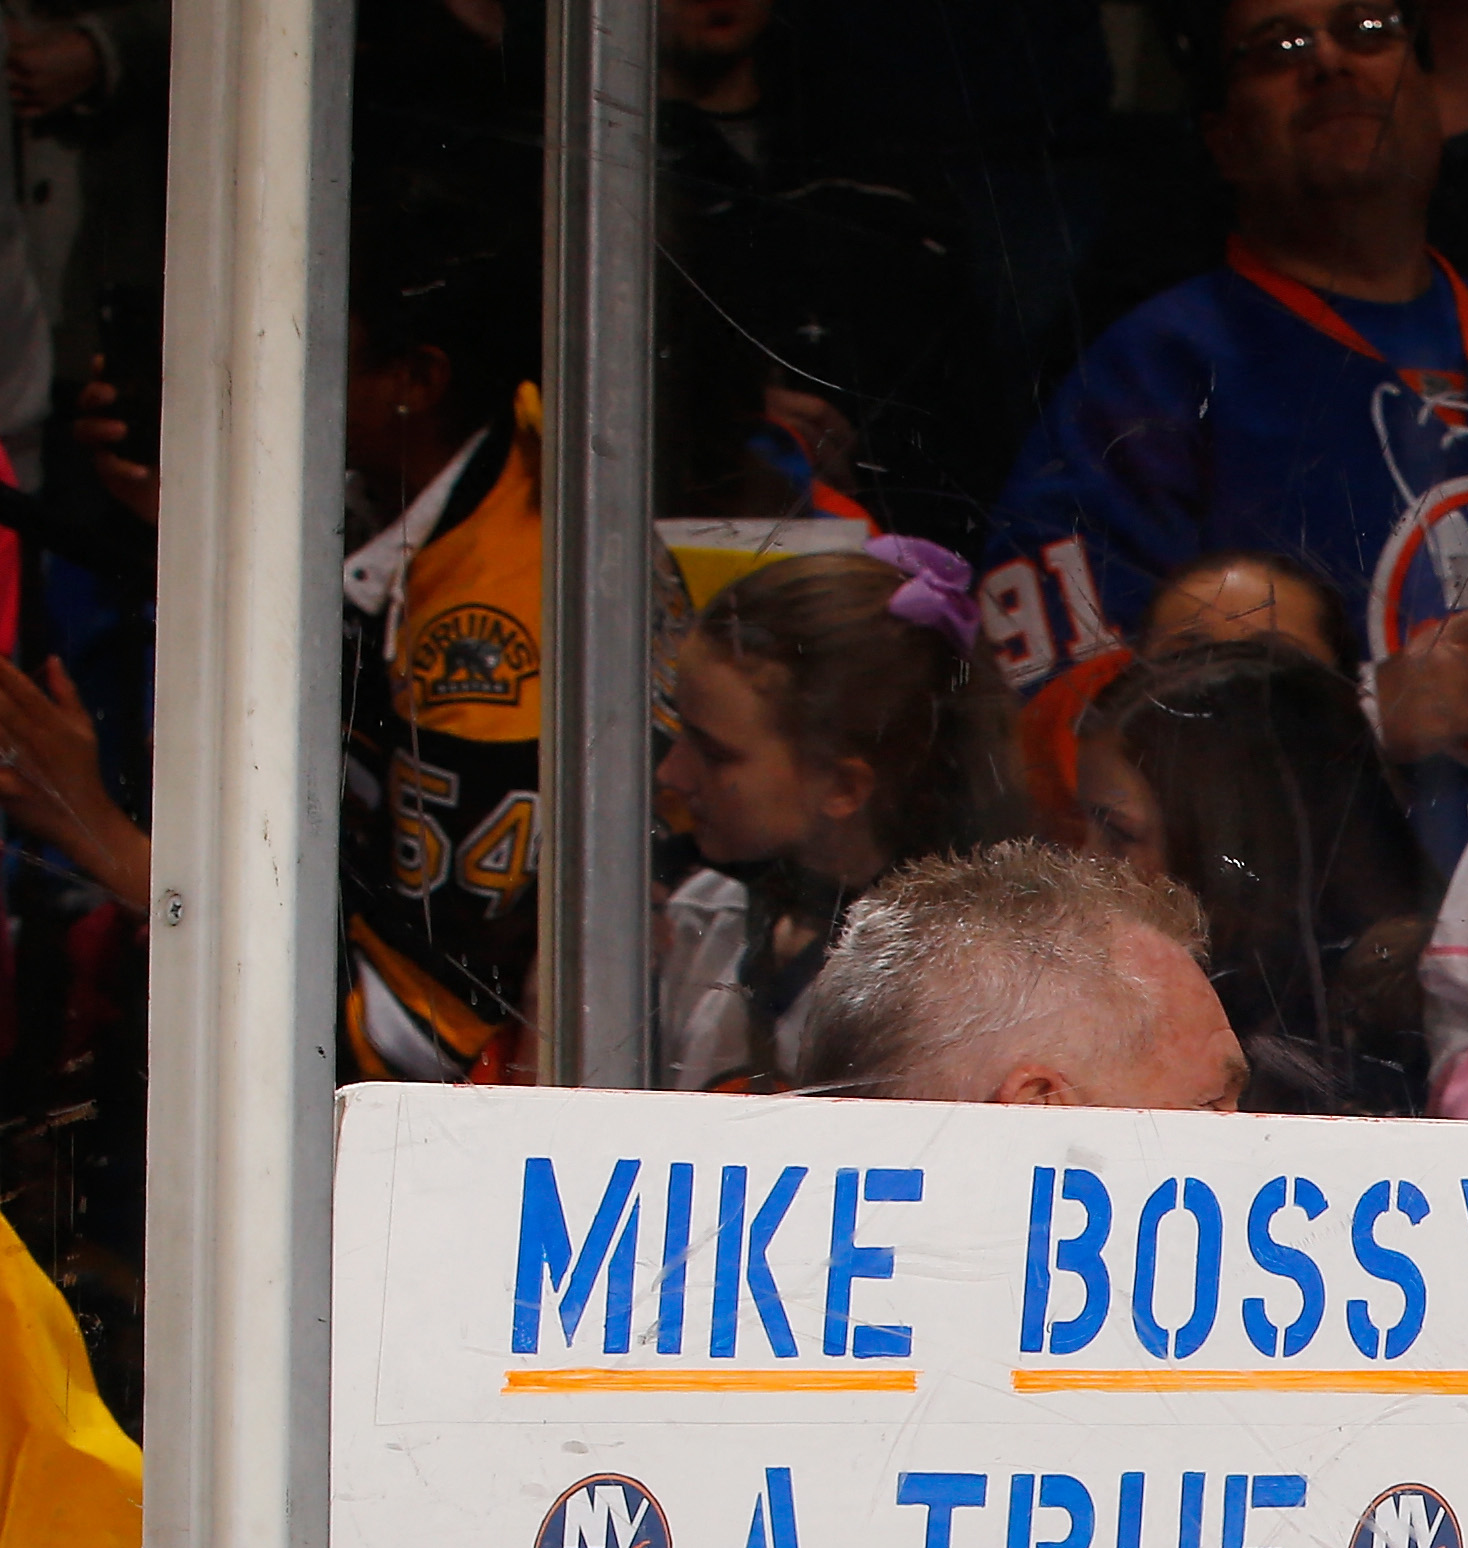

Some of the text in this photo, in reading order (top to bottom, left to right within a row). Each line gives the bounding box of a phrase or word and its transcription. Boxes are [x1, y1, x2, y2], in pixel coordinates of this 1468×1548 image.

[412, 611, 532, 671] BRUINS
[980, 534, 1125, 690] 91
[510, 1156, 925, 1359] MIKE
